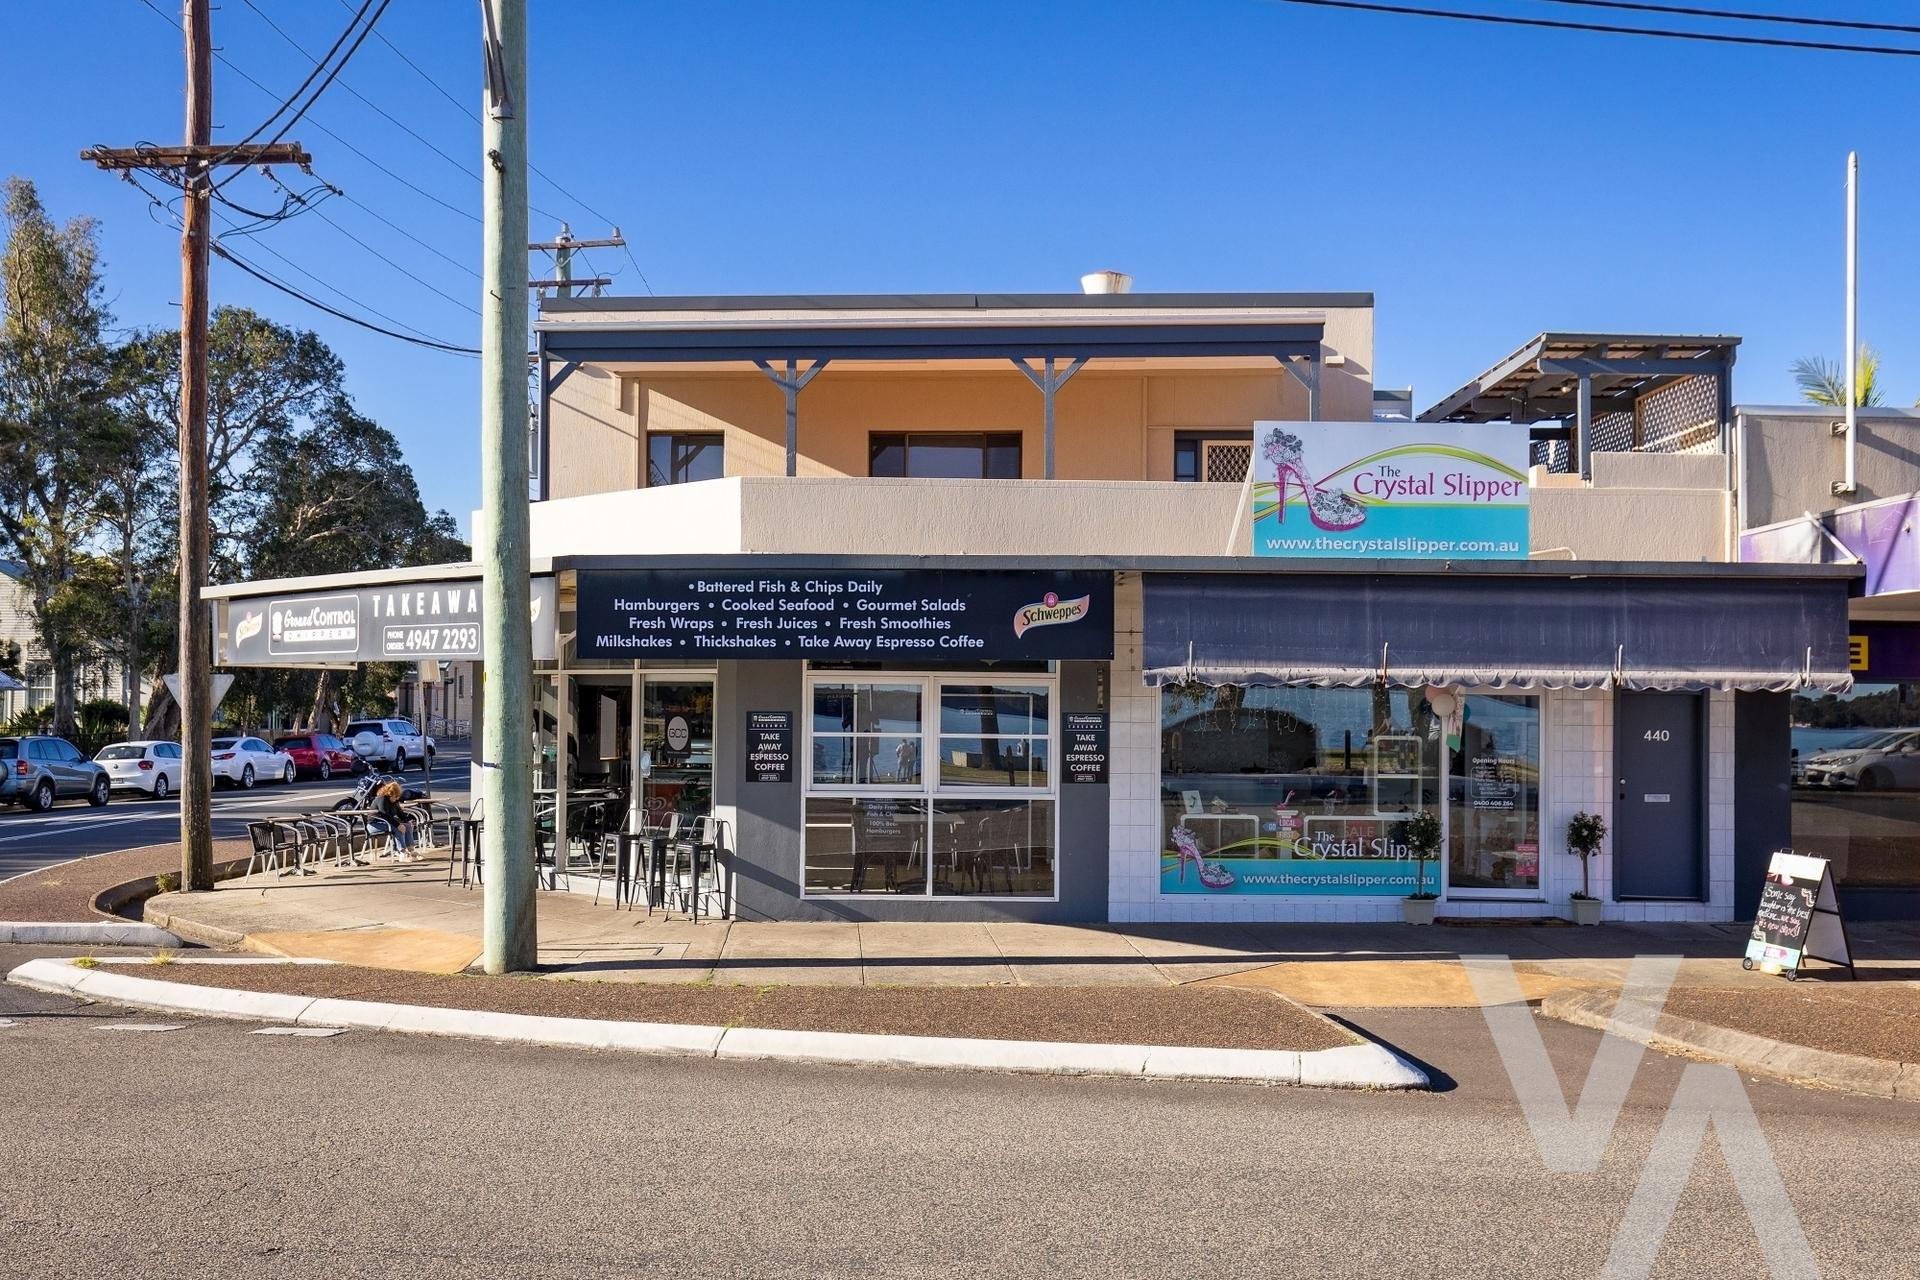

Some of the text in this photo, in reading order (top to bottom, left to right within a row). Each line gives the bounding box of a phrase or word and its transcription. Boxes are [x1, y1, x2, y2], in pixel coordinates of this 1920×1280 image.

[1378, 465, 1401, 477] The
[1354, 472, 1523, 501] Crystal Slipper
[1267, 537, 1519, 553] www.thecrystalslipper.com.au
[698, 581, 882, 595] Battered Fish & Chips Daily
[372, 588, 478, 617] TAKEAWA
[615, 599, 966, 613] Hamburgers Cooked Seafood Gourmet Salads
[1022, 604, 1082, 626] Schweppes
[630, 617, 950, 631] Fresh Wraps Fresh Juices Fresh Smoothies
[387, 631, 404, 639] PHONE
[406, 628, 477, 650] 4947 2293
[386, 641, 405, 650] ORDERS
[596, 635, 984, 650] Milkshakes Thickshakes Take Away Espresso Coffee
[760, 733, 780, 741] TAKE
[1643, 729, 1670, 741] 440
[750, 753, 789, 761] ESPRESSO
[1066, 754, 1105, 762] ESPRESSO
[754, 763, 785, 771] COFFEE
[1279, 818, 1297, 827] LOCAL
[1315, 831, 1335, 842] The
[1294, 836, 1363, 860] Crystal
[1243, 873, 1435, 887] www.thecrystalslipper.com.au
[1784, 892, 1797, 907] say
[1796, 906, 1810, 920] best
